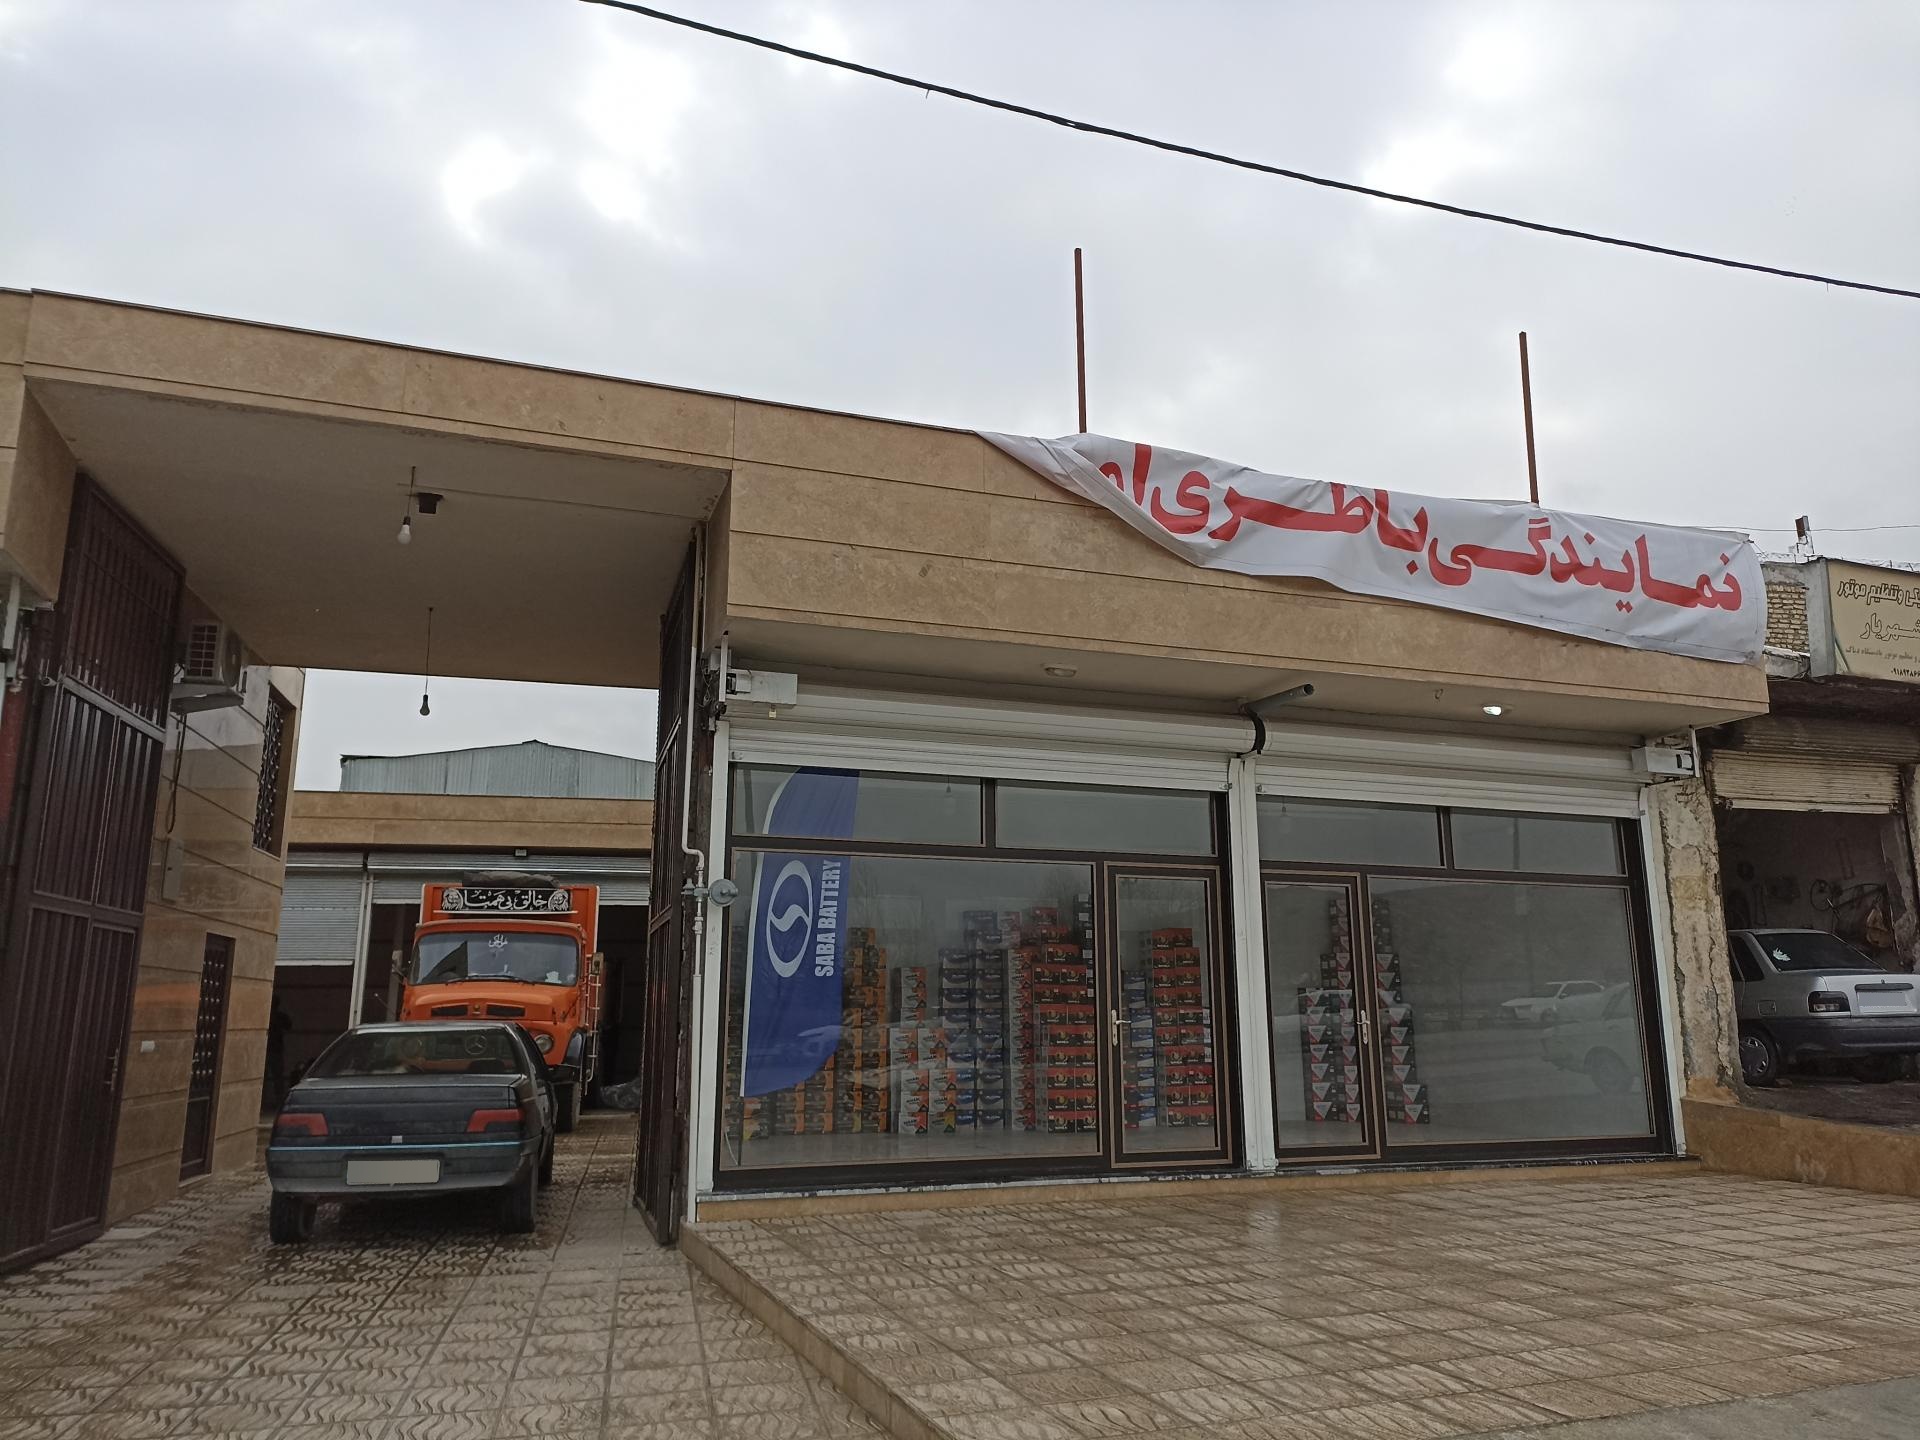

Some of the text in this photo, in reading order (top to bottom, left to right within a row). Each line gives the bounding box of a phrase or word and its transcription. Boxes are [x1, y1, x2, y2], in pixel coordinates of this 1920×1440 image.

[1151, 471, 1428, 574] باطری
[1428, 516, 1742, 613] نمایندگی
[1837, 578, 1867, 600] موتور
[464, 889, 548, 910] خالق بی همتا
[815, 859, 841, 977] SABA BATTERY
